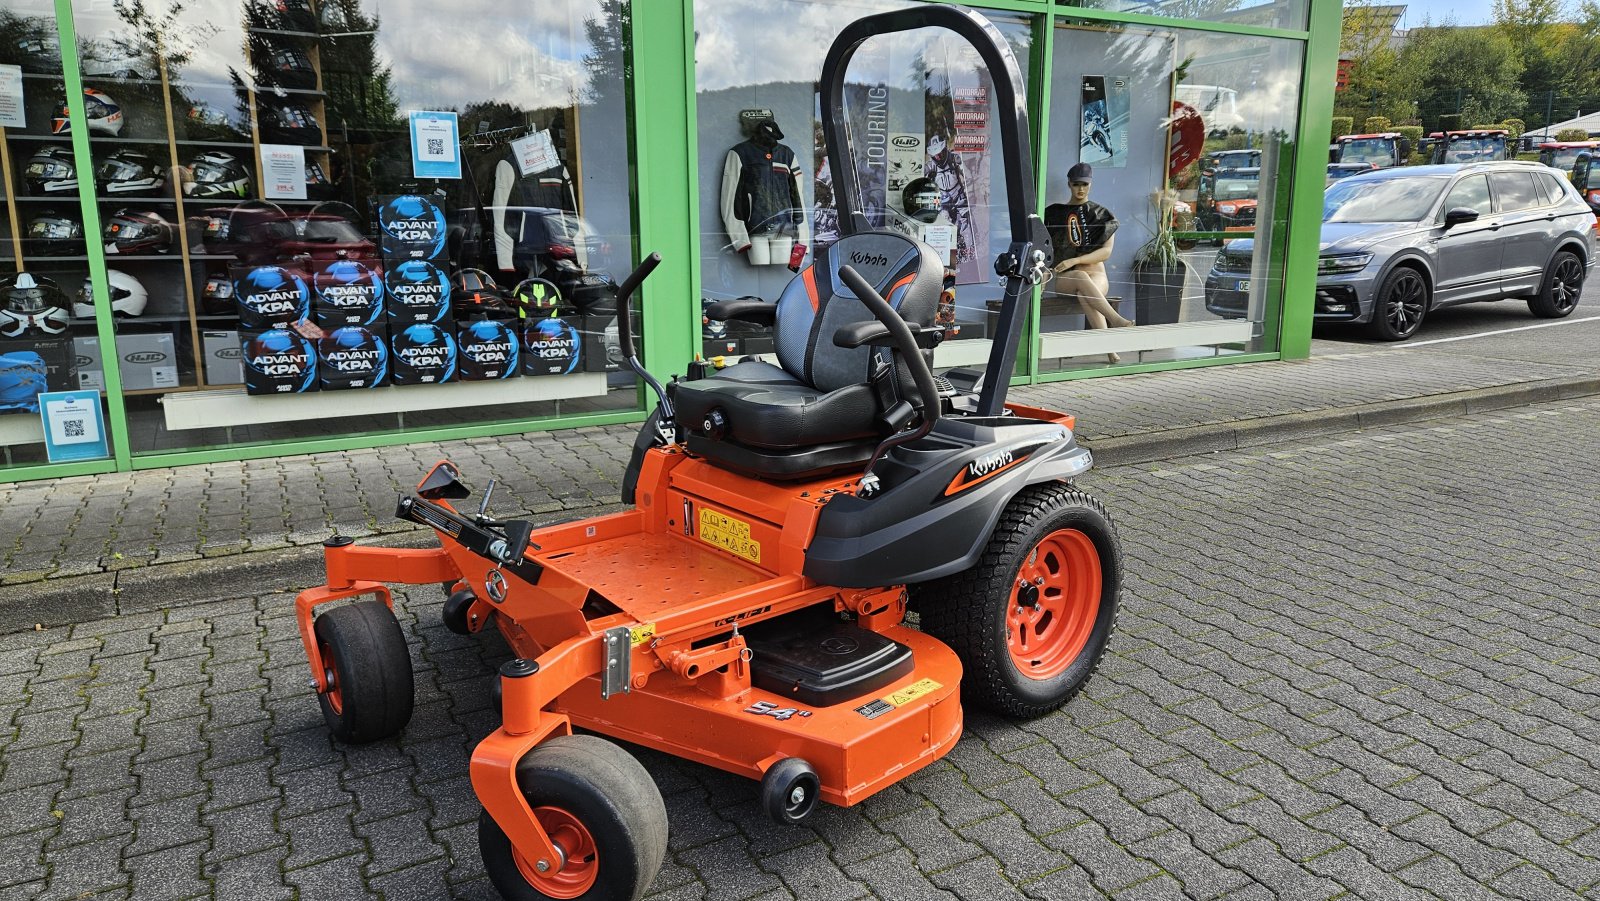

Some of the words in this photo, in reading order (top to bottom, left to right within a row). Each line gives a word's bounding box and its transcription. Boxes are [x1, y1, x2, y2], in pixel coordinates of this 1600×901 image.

[955, 87, 986, 96] MOTORRAD
[954, 112, 985, 121] MOTORRAD
[867, 87, 887, 168] TOURING
[954, 135, 985, 144] MOTORRAD
[387, 221, 440, 231] ADVANT
[397, 230, 432, 240] KPA
[850, 251, 888, 266] Kubota
[322, 285, 377, 296] ADVANT
[393, 285, 444, 295] ADVANT
[245, 290, 302, 304] ADVANT
[333, 295, 369, 306] KPA
[403, 294, 436, 304] KPA
[257, 301, 295, 314] KPA
[465, 342, 513, 353] ADVANT
[530, 339, 576, 349] ADVANT
[327, 350, 381, 361] ADVANT
[400, 346, 451, 358] ADVANT
[475, 352, 506, 362] KPA
[540, 348, 569, 358] KPA
[252, 354, 310, 365] ADVANT
[410, 356, 443, 367] KPA
[264, 364, 301, 375] KPA
[337, 360, 373, 371] KPA
[969, 449, 1014, 477] Kubota
[714, 604, 772, 627] K-LIFT
